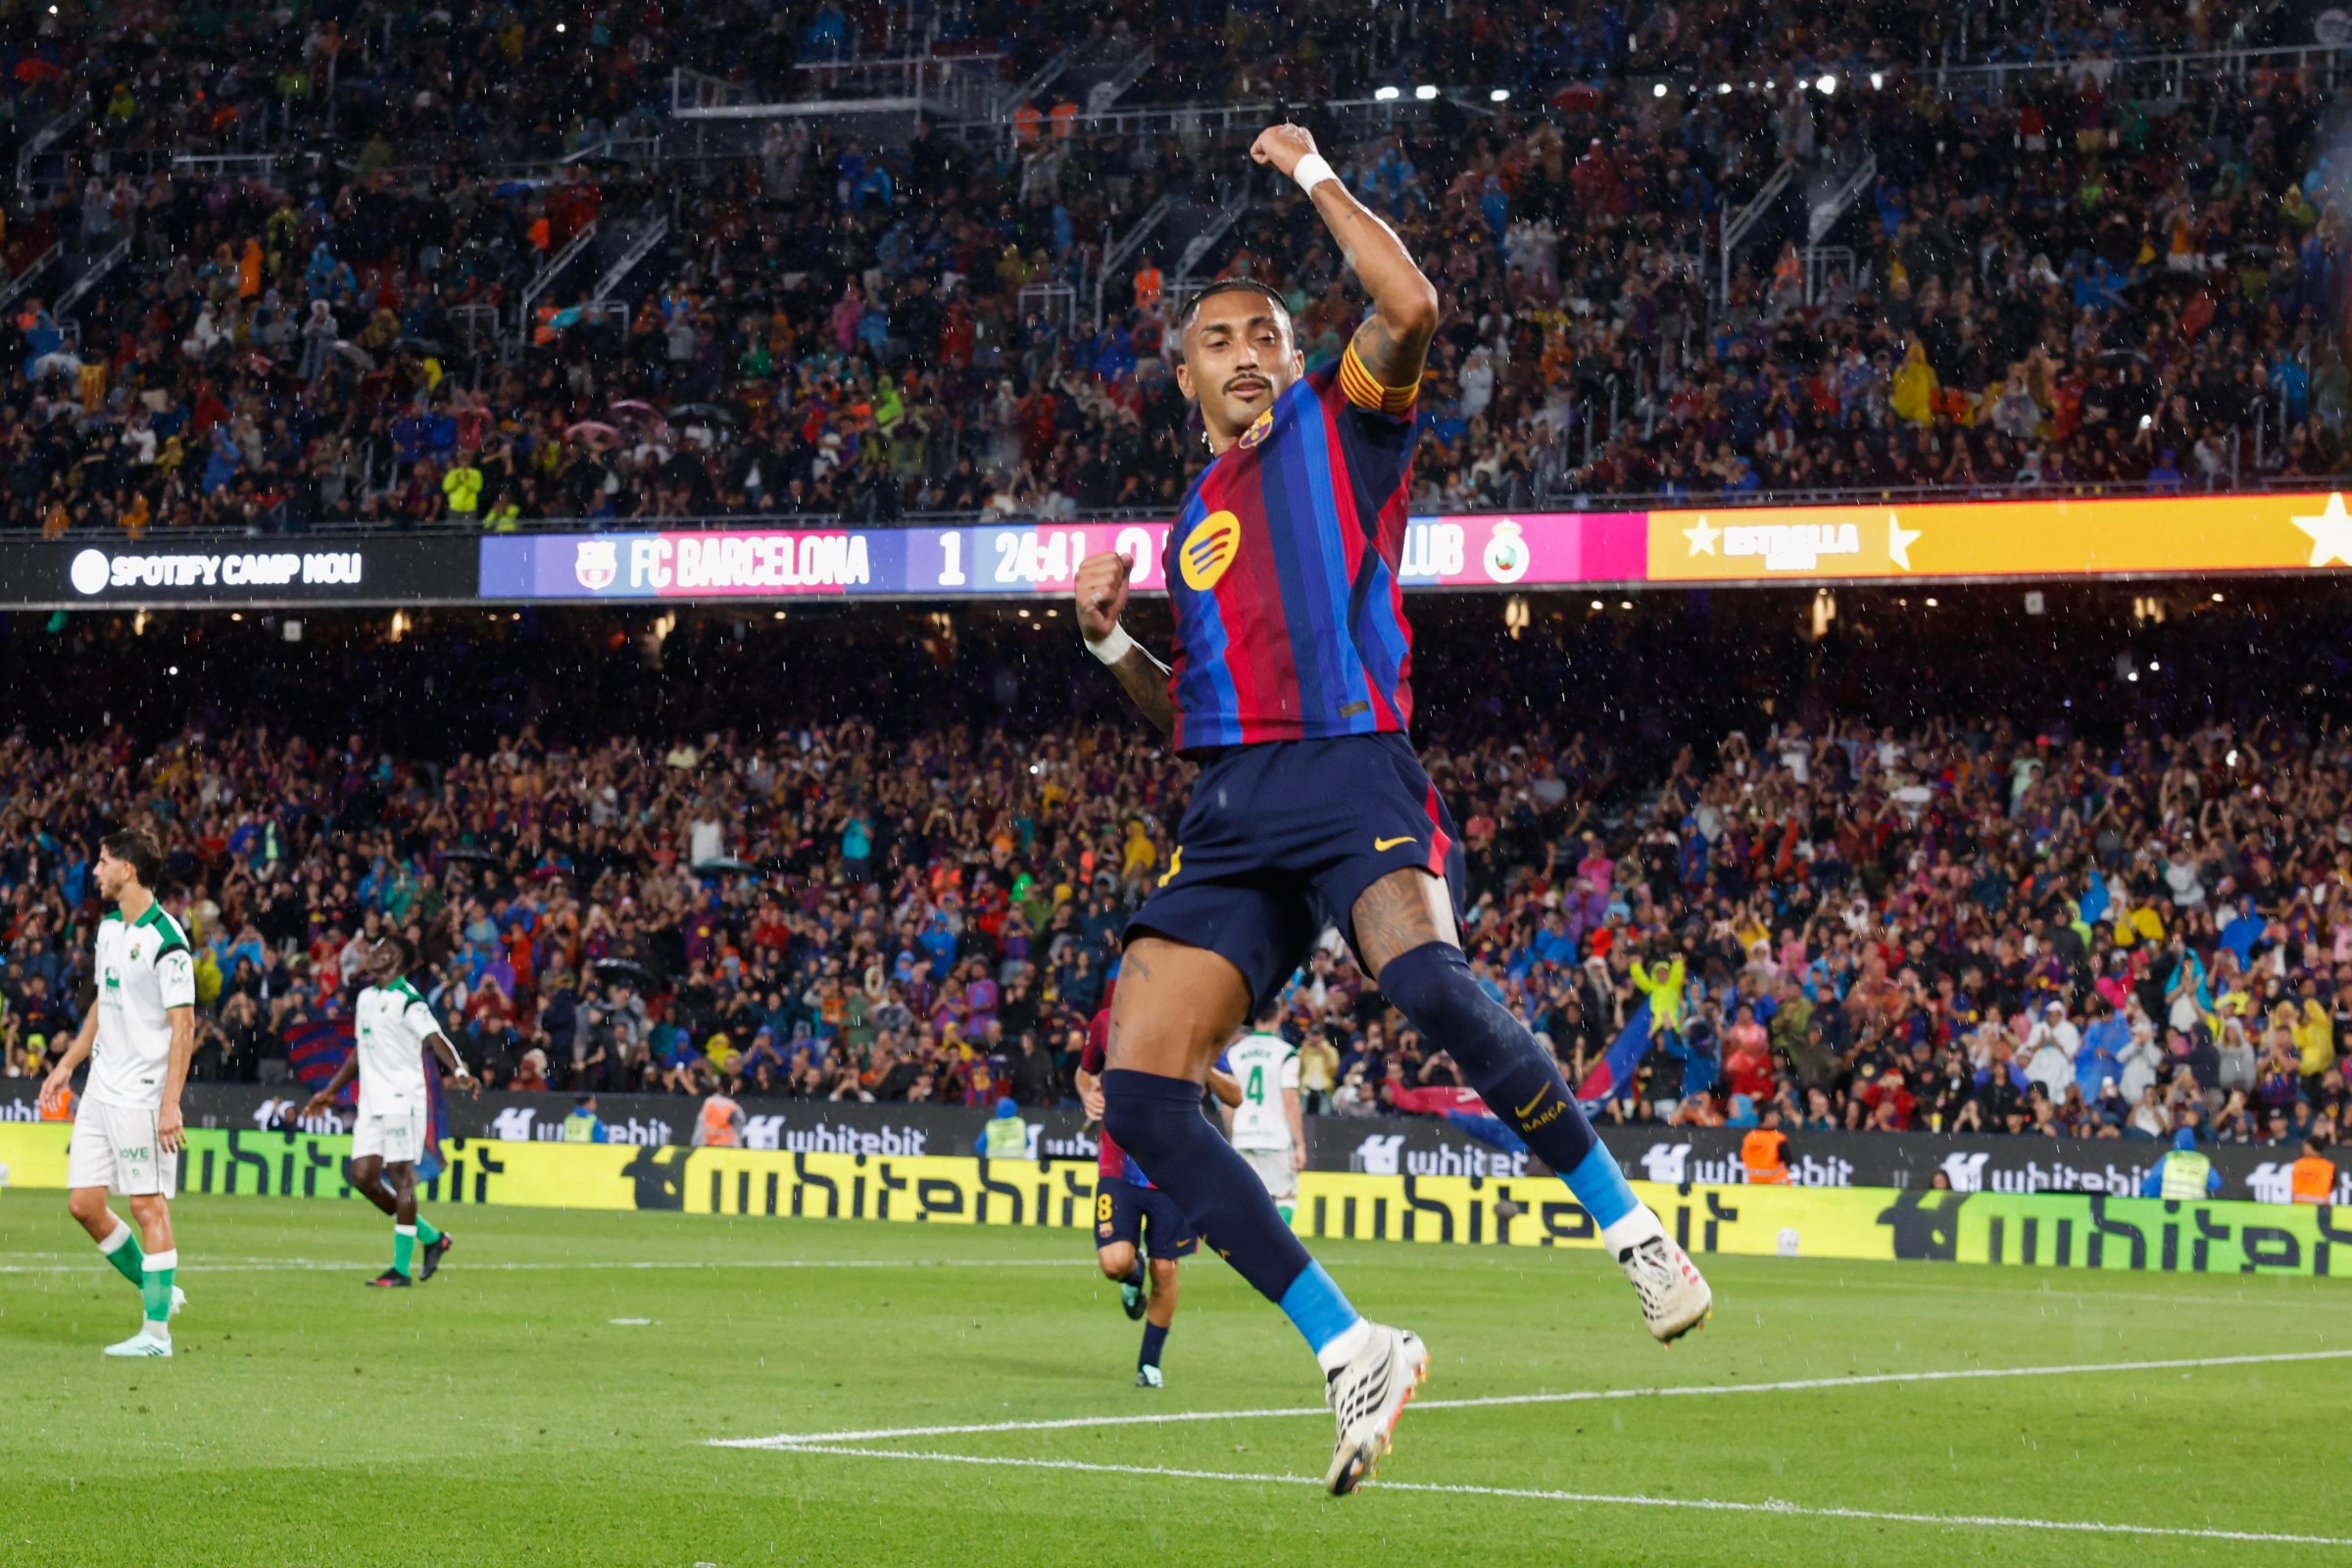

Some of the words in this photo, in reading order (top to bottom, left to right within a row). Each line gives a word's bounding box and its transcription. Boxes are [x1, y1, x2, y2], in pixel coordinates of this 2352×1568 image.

[110, 555, 220, 586] SPOTIFY
[221, 554, 301, 585] CAMP
[303, 553, 363, 584] NOU
[630, 538, 672, 588] FC
[676, 535, 870, 588] BARCELONA
[938, 531, 965, 585] 1
[1115, 527, 1152, 583] 0
[1399, 523, 1464, 576] LUB
[1246, 1065, 1264, 1106] 4
[786, 1122, 927, 1156] whitebit
[1097, 1194, 1113, 1222] 8
